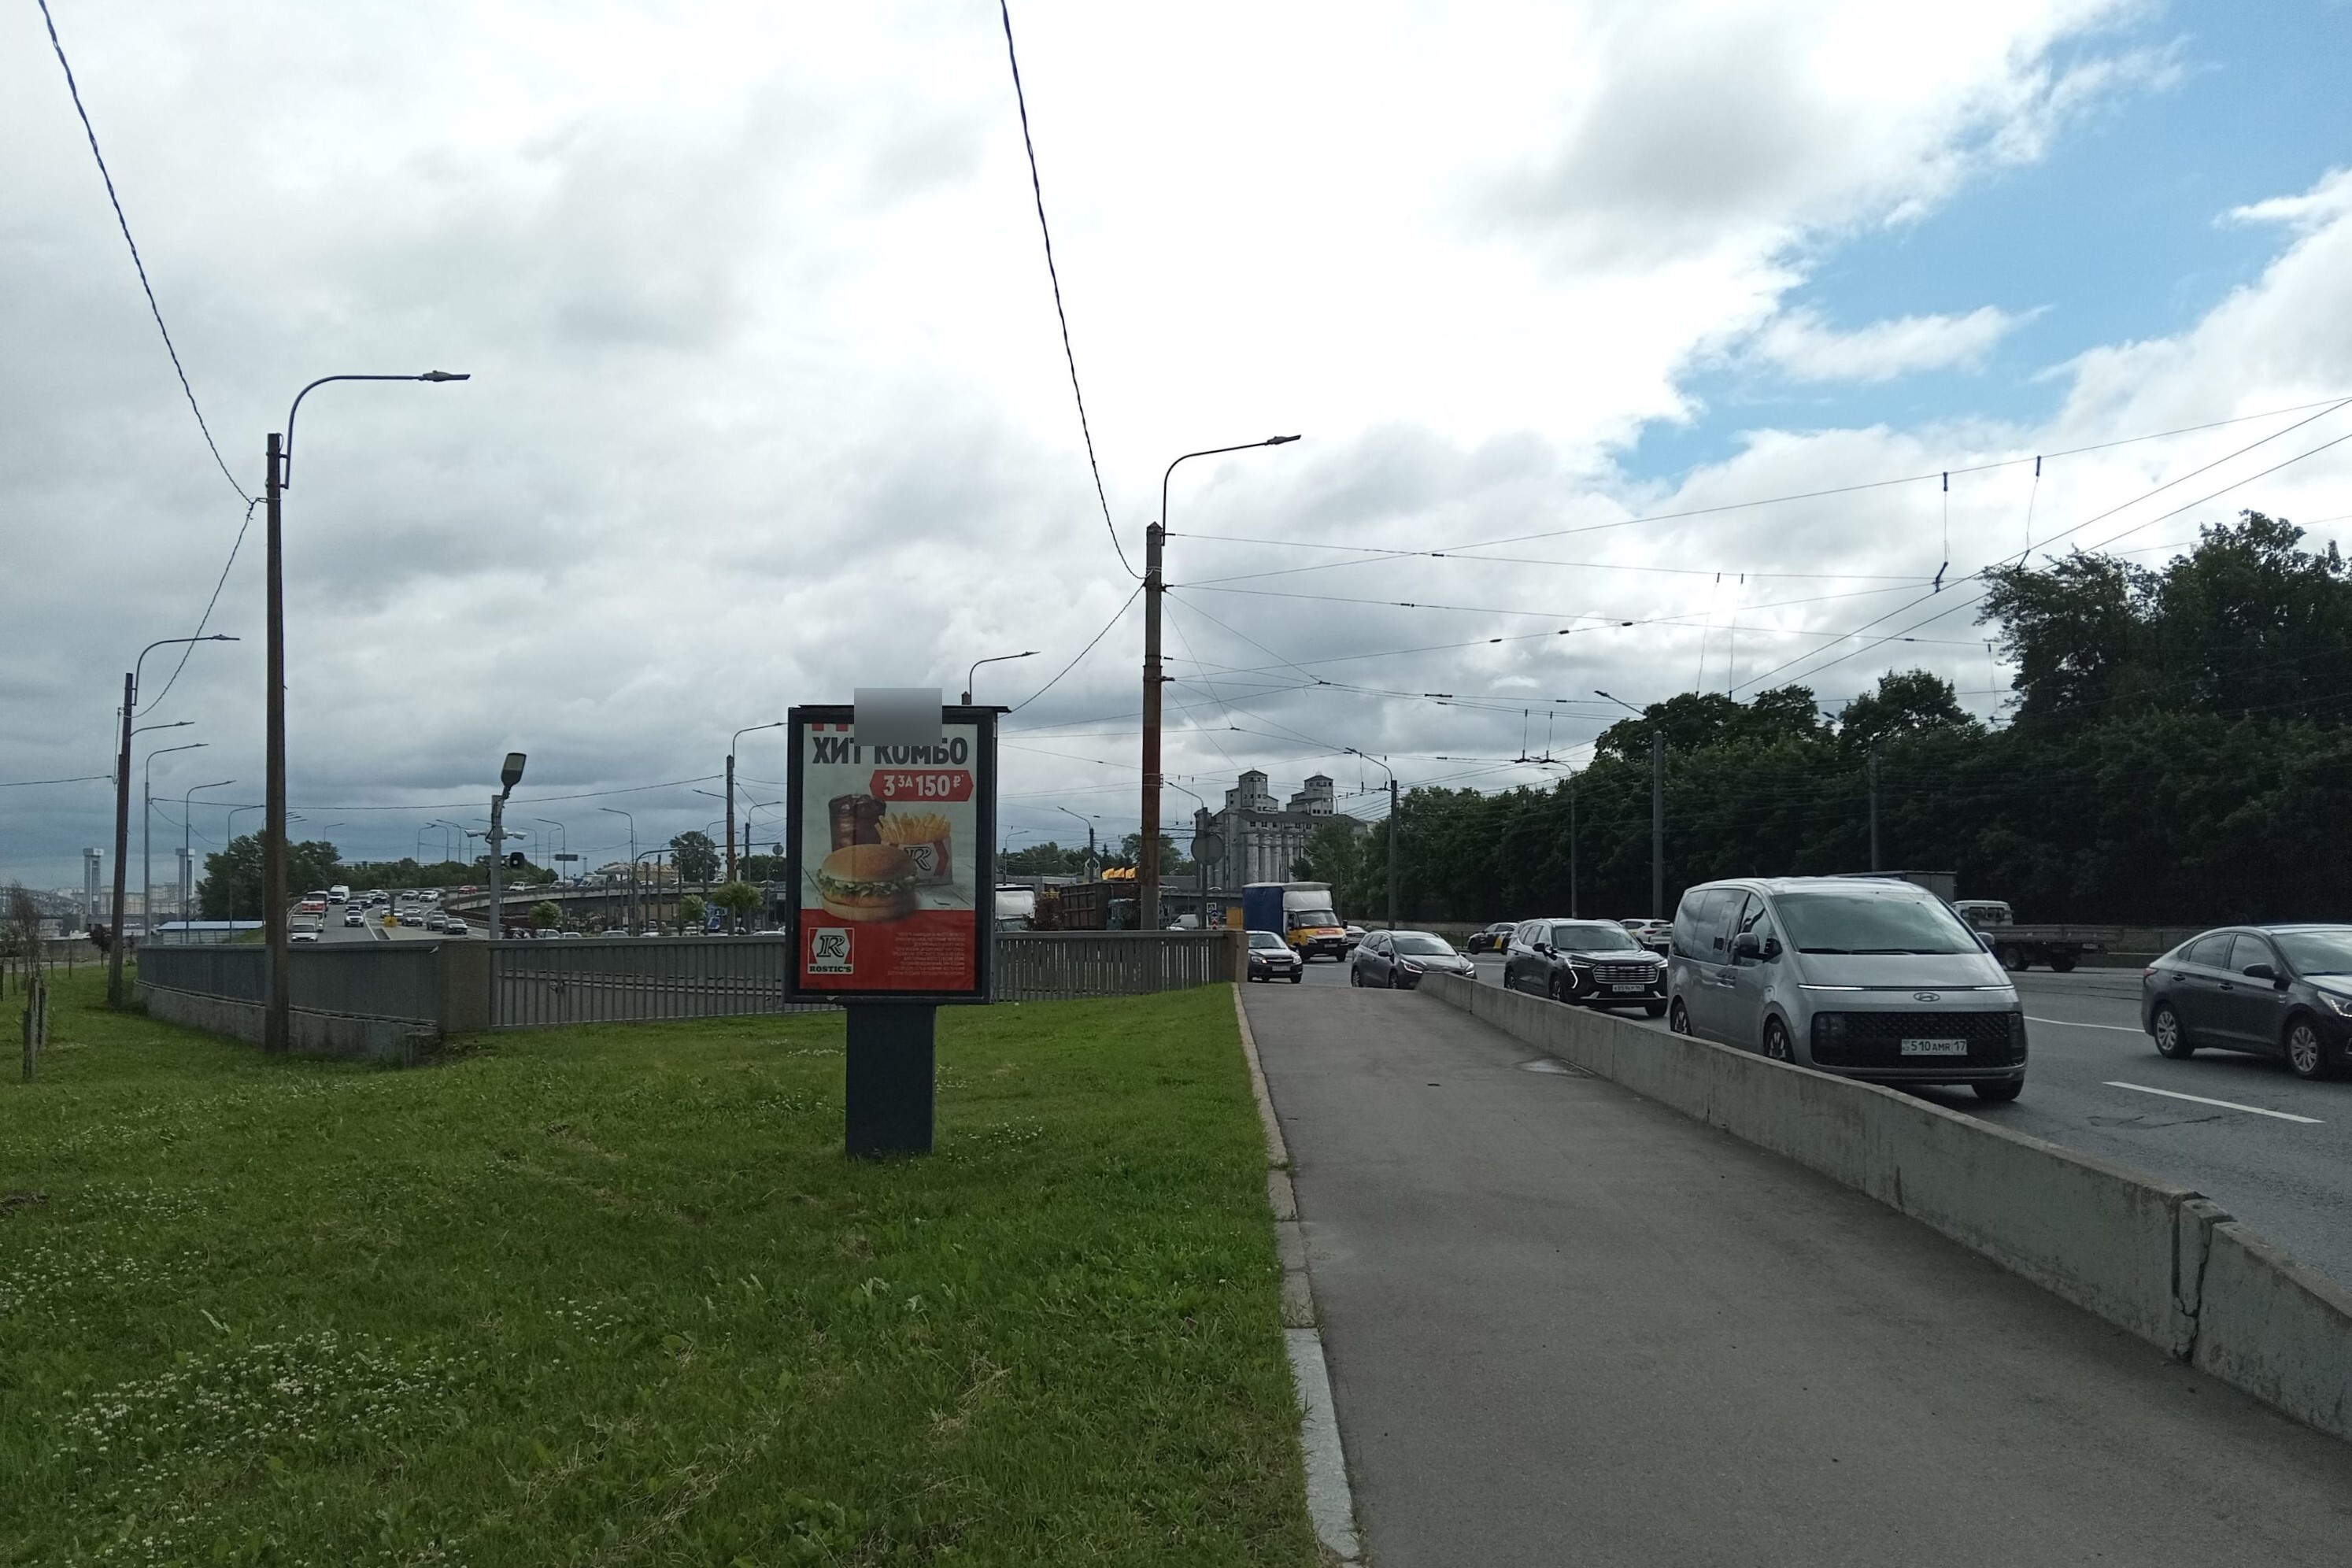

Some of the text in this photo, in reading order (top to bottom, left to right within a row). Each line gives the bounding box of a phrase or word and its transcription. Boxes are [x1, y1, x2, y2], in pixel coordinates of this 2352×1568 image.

[812, 737, 968, 765] ХИТ КОМБО
[883, 775, 895, 797] 3
